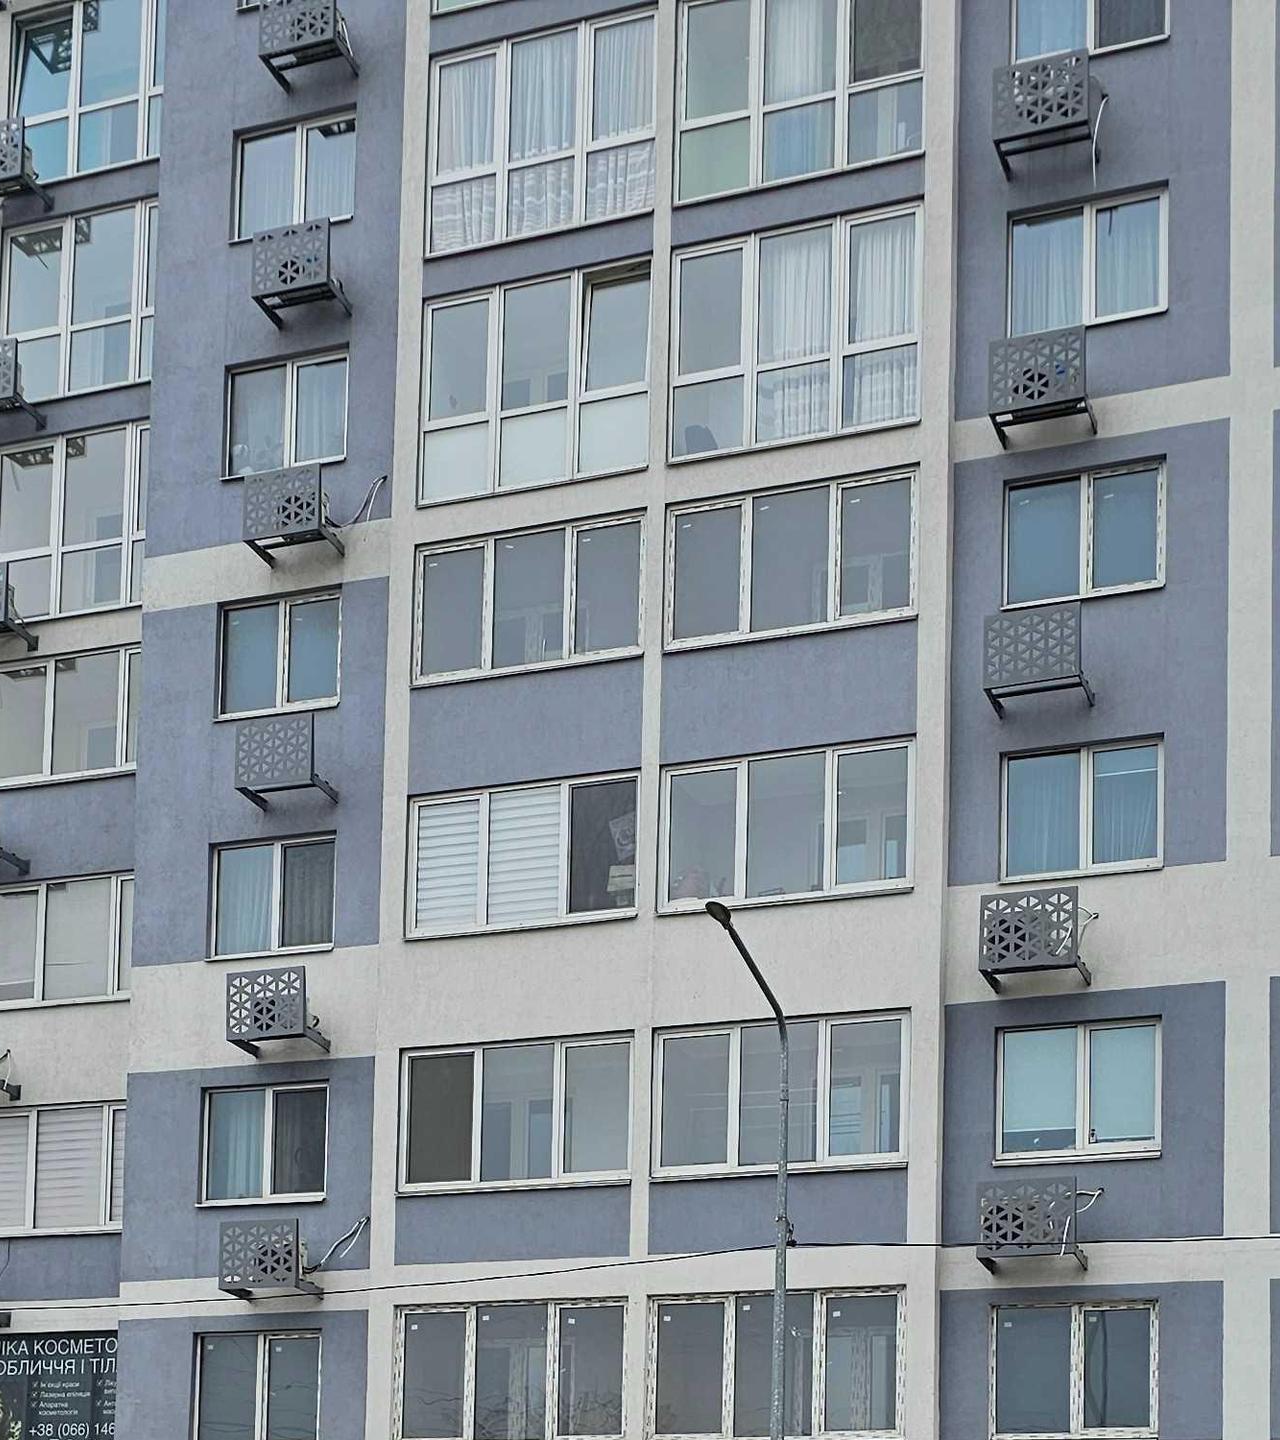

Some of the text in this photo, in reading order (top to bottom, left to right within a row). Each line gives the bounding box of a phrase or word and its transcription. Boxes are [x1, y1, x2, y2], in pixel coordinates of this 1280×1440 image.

[33, 1337, 118, 1356] КОСМЕТО
[89, 1357, 118, 1375] ТІЛ
[29, 1423, 54, 1437] +38
[57, 1422, 90, 1439] (066)
